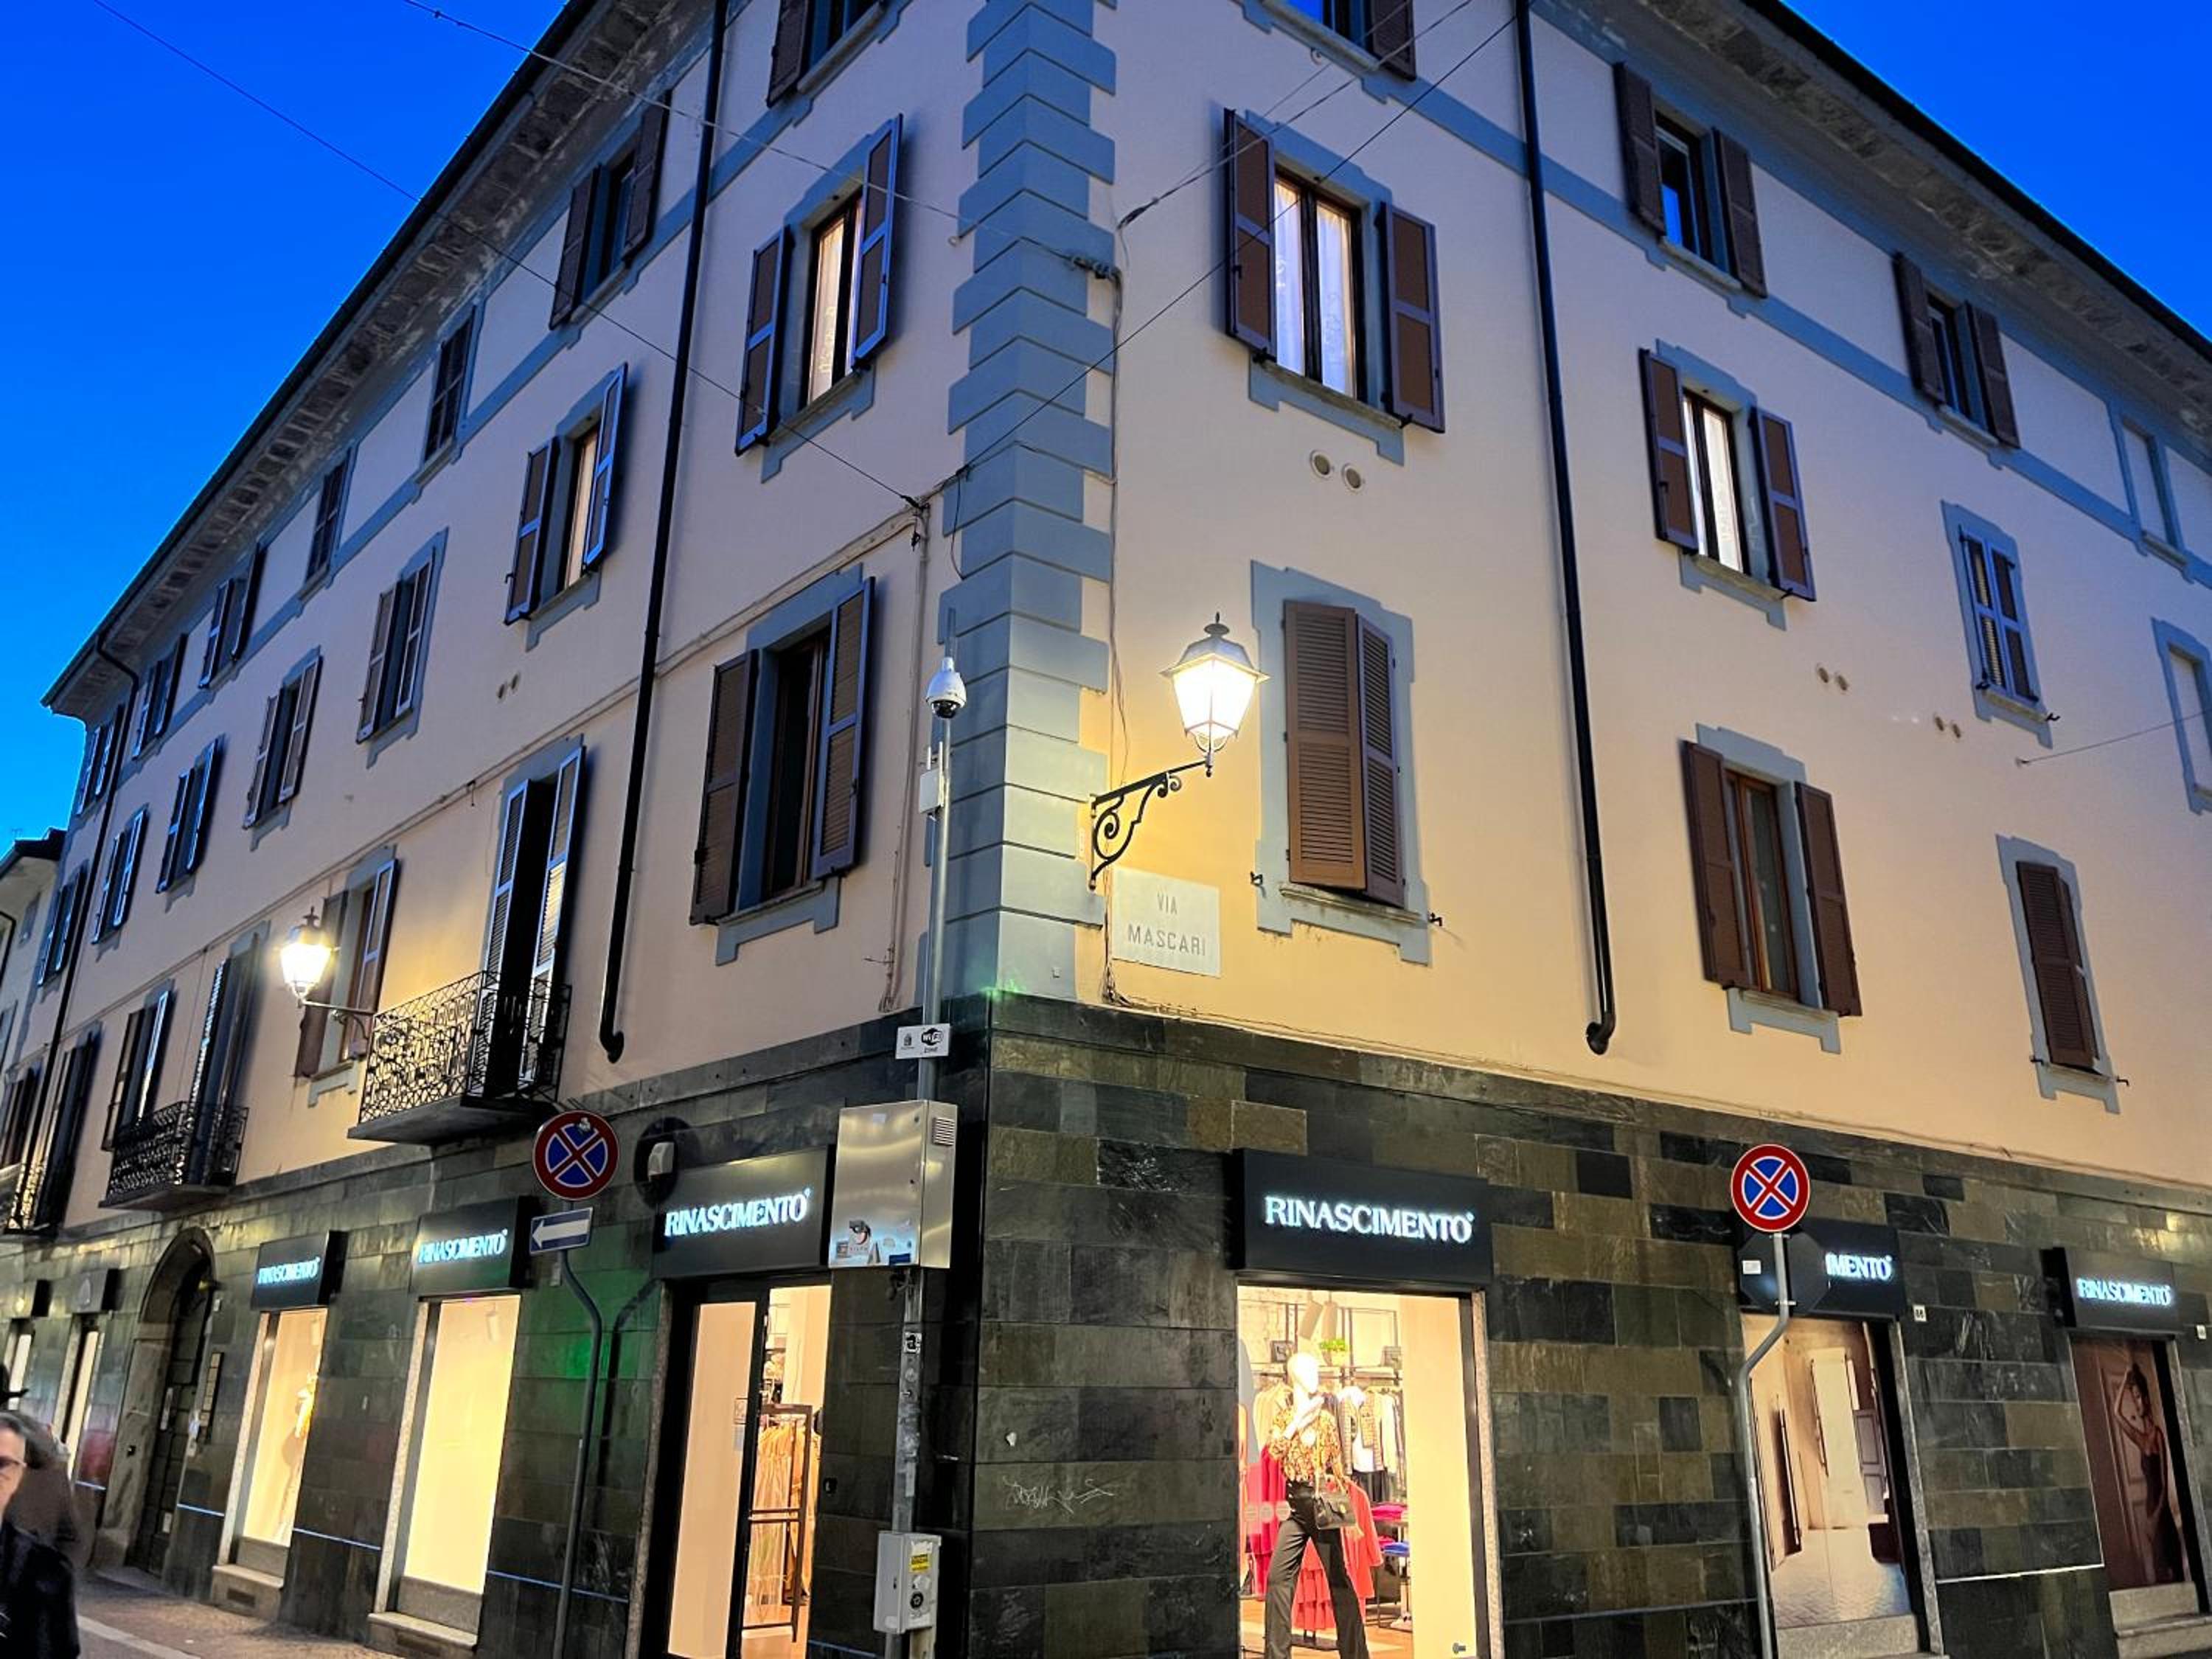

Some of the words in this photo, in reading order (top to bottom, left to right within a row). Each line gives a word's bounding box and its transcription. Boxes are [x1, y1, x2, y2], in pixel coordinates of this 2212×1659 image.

[1156, 891, 1178, 915] VIA
[1127, 923, 1206, 956] MASCARI
[664, 1191, 810, 1237] RINASCIMENTO
[1264, 1196, 1474, 1243] RINASCIMENTO
